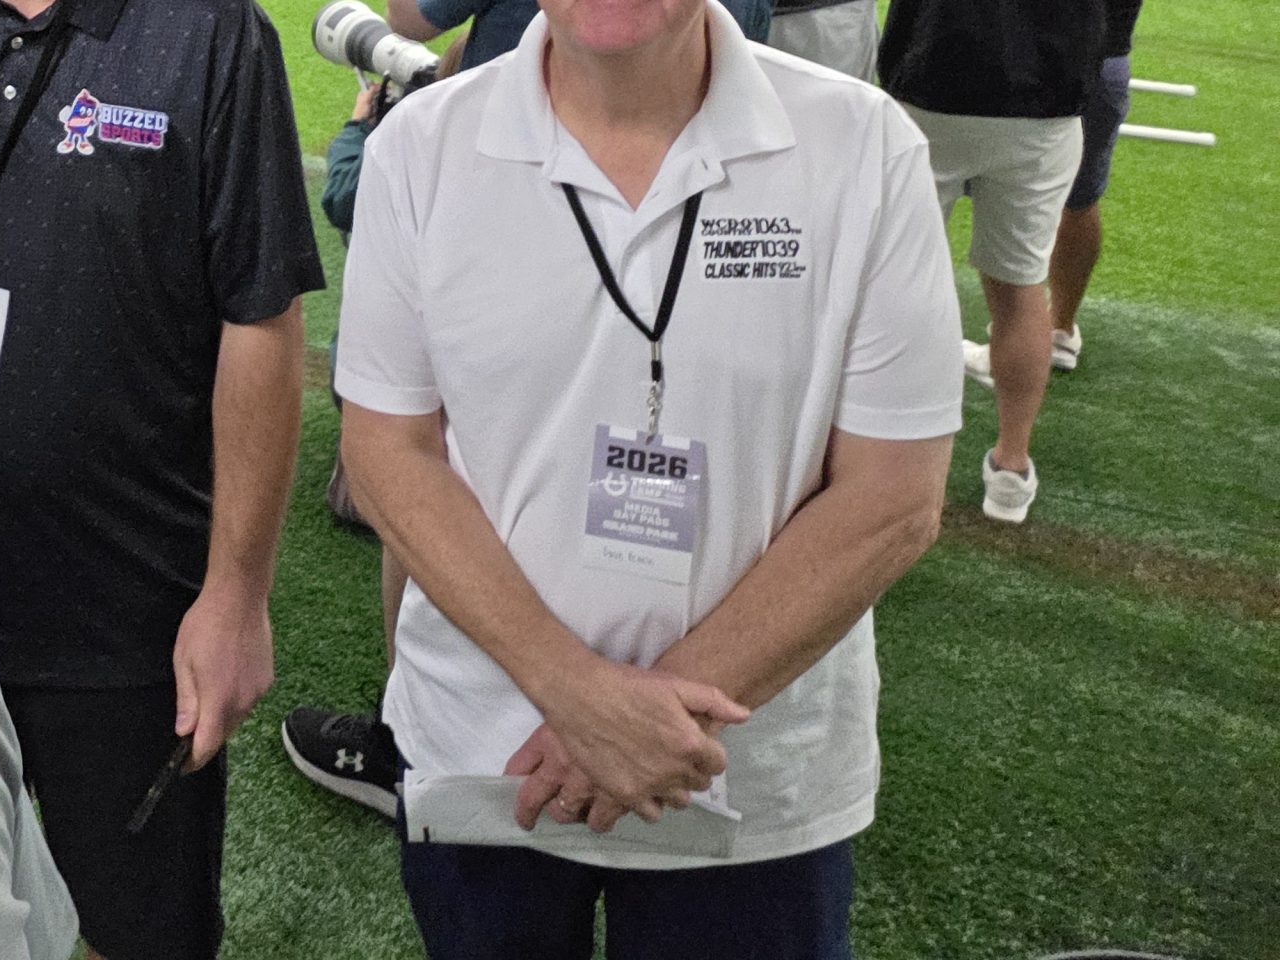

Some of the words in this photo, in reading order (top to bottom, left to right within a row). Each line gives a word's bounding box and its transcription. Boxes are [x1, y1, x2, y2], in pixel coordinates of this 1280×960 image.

[100, 106, 167, 131] BUZZED
[101, 123, 162, 146] SPORTS
[705, 262, 751, 279] CLASSIC
[751, 262, 777, 278] HITS
[606, 445, 688, 480] 2026
